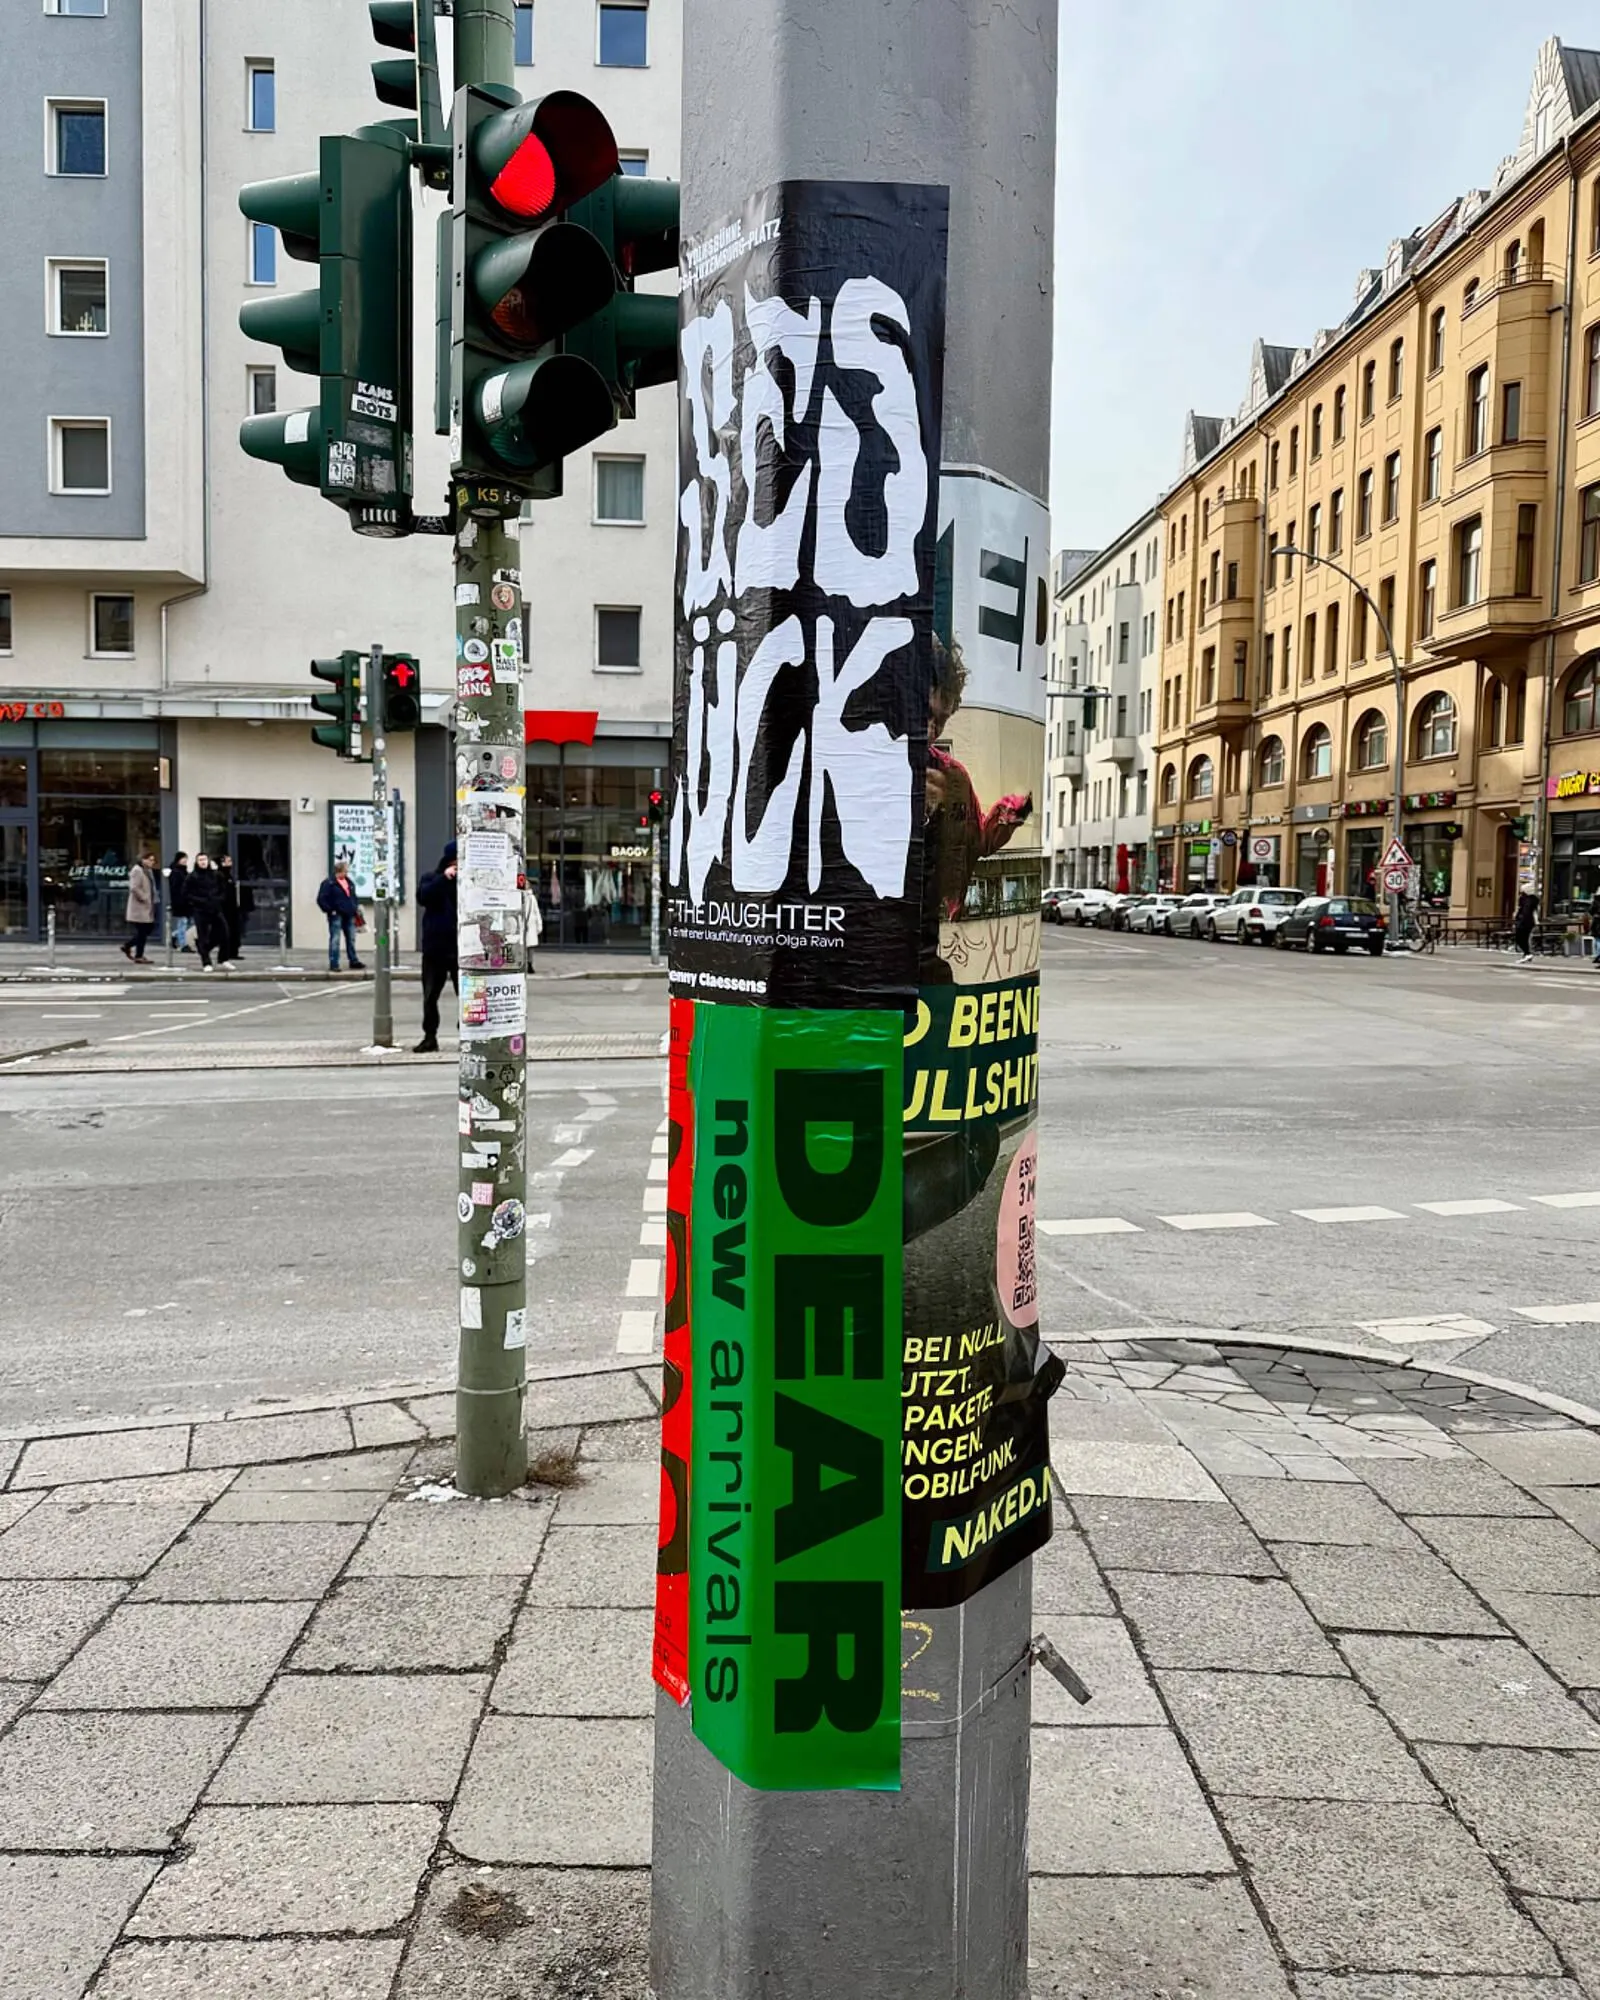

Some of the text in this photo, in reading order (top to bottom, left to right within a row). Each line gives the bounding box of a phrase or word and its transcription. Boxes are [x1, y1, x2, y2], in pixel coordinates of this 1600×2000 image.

[356, 399, 393, 418] ROTS
[477, 487, 499, 502] K5
[1556, 773, 1586, 797] ANGRY
[301, 798, 309, 809] 7
[611, 846, 650, 857] BAGGY
[68, 865, 90, 877] LIFE
[1388, 874, 1402, 886] 30
[675, 899, 705, 925] THE
[709, 901, 845, 932] DAUGHTER
[753, 933, 774, 945] von
[776, 934, 807, 949] Olga
[810, 935, 844, 948] Ravn
[486, 984, 521, 997] SPORT
[669, 970, 767, 994] enny Claessens
[903, 1319, 1006, 1363] BEI NULL
[705, 1099, 752, 1703] new arrivals
[774, 1068, 884, 1734] DEAR
[904, 1384, 993, 1431] PAKETE.
[901, 1426, 983, 1466] NGEN.
[901, 1437, 1017, 1500] OBILFUNK.
